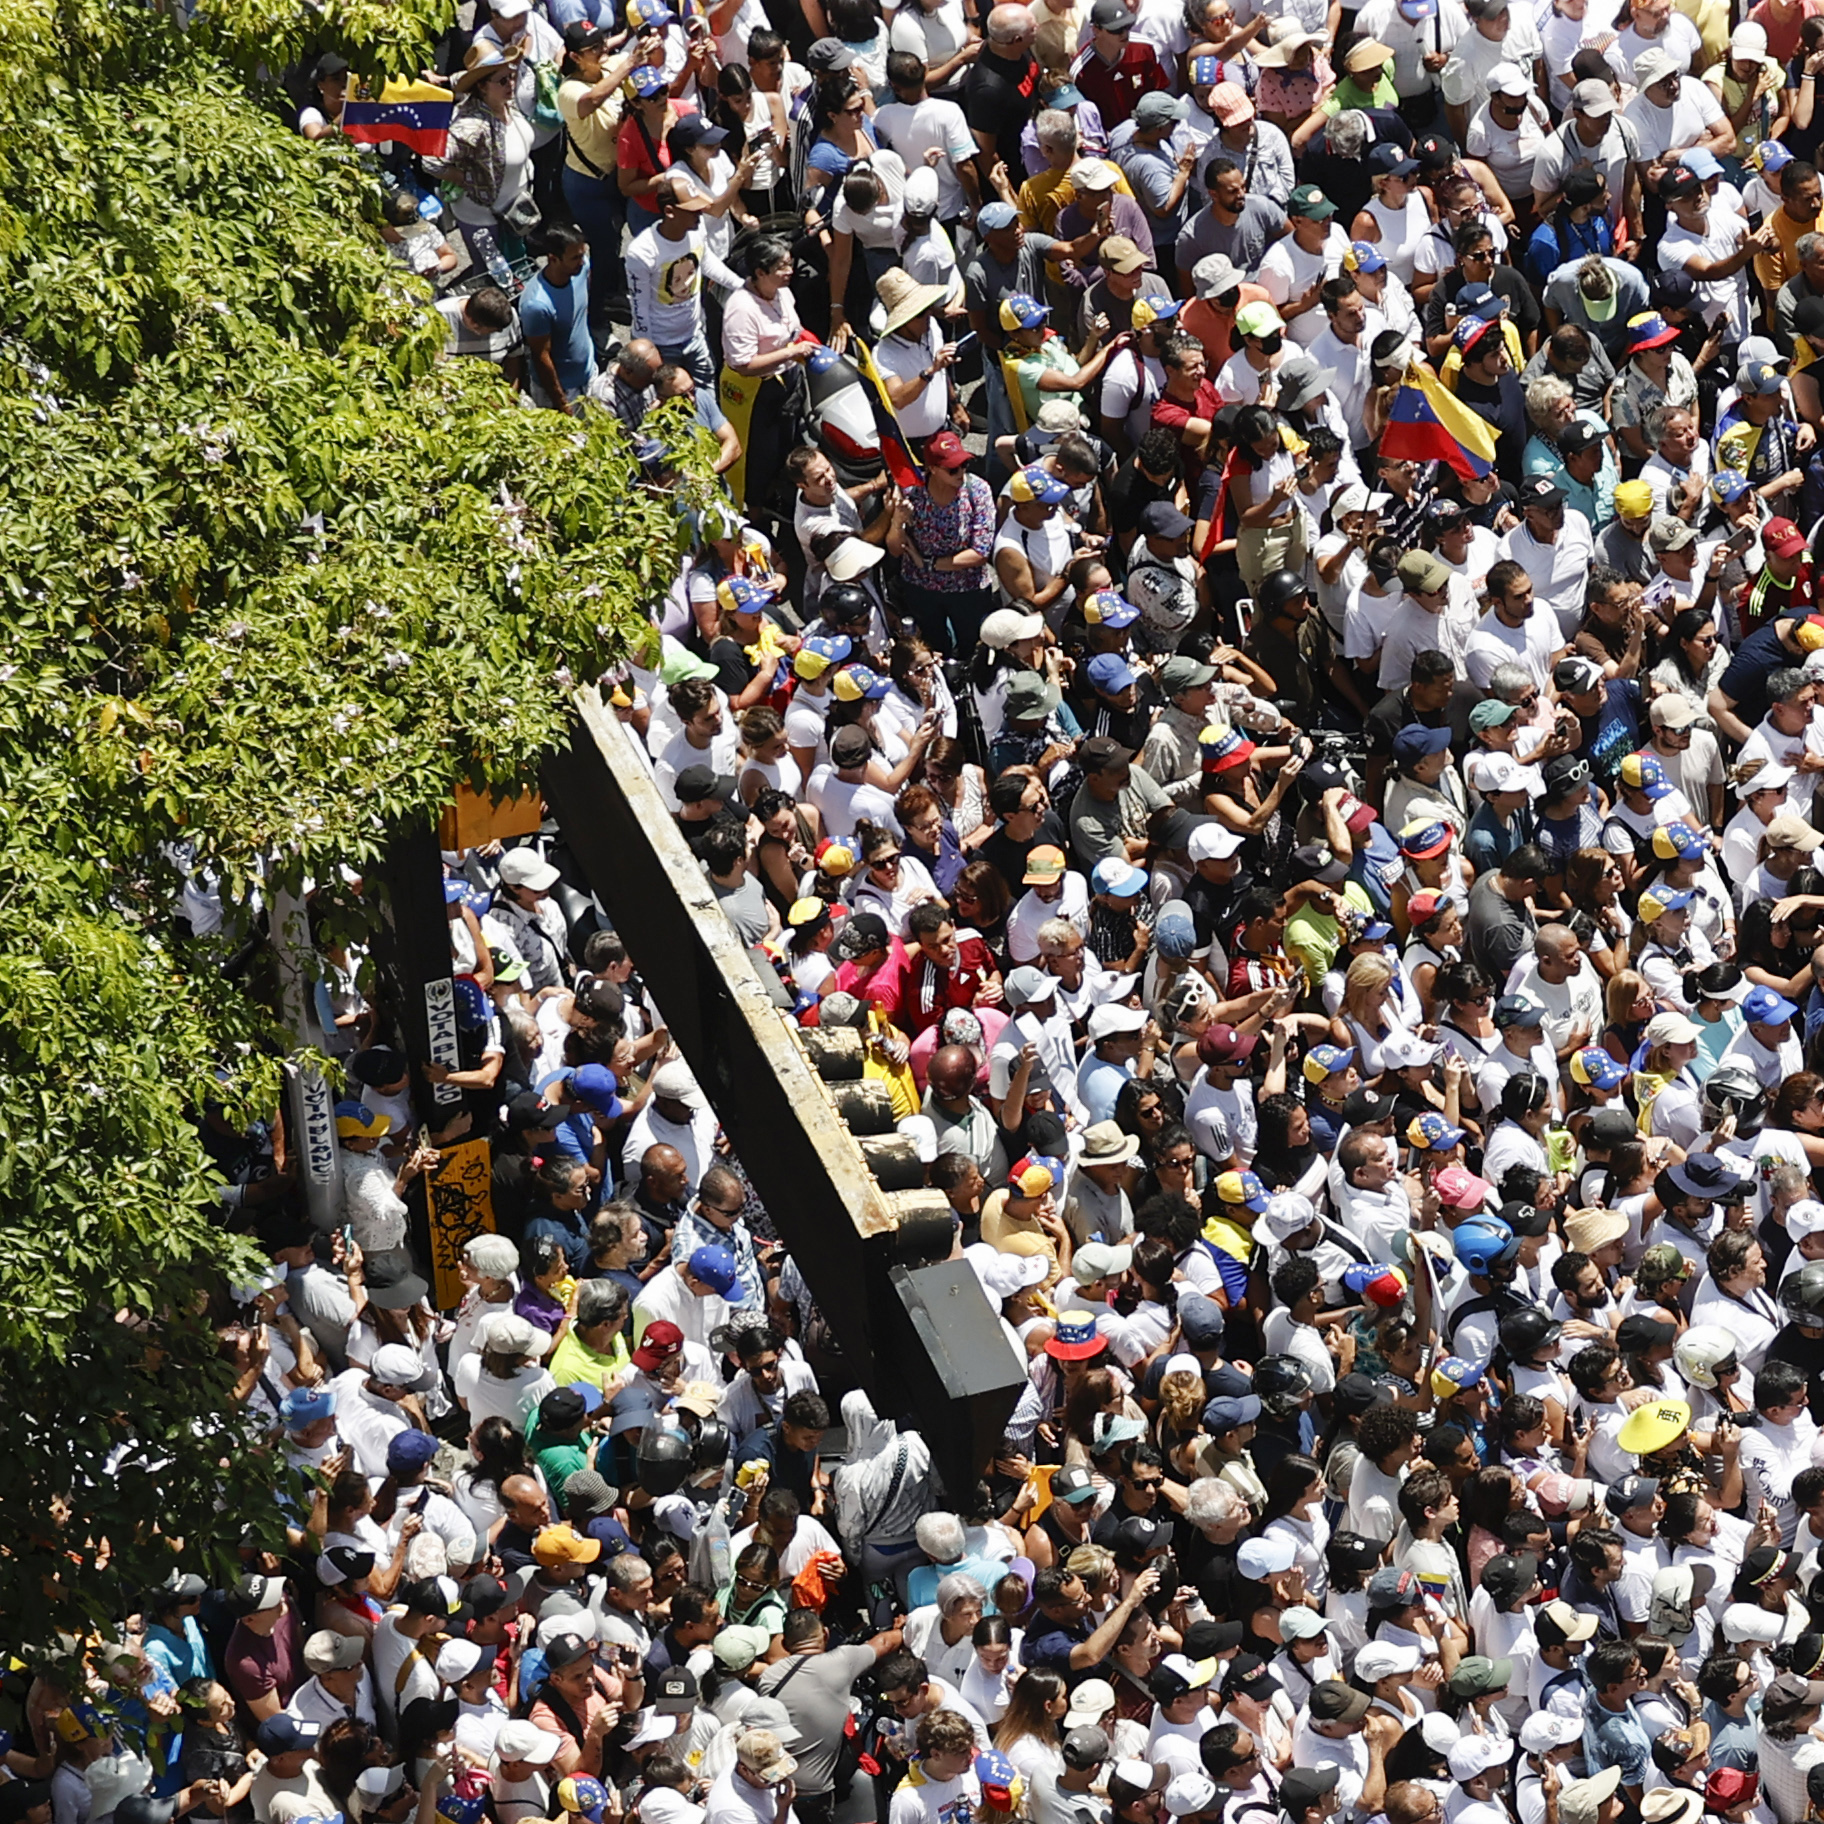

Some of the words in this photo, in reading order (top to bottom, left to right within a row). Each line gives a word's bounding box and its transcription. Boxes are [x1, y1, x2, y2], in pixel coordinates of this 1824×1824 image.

[430, 1003, 453, 1041] VOTA
[433, 1044, 462, 1101] BLCO
[304, 1080, 327, 1121] VOTA
